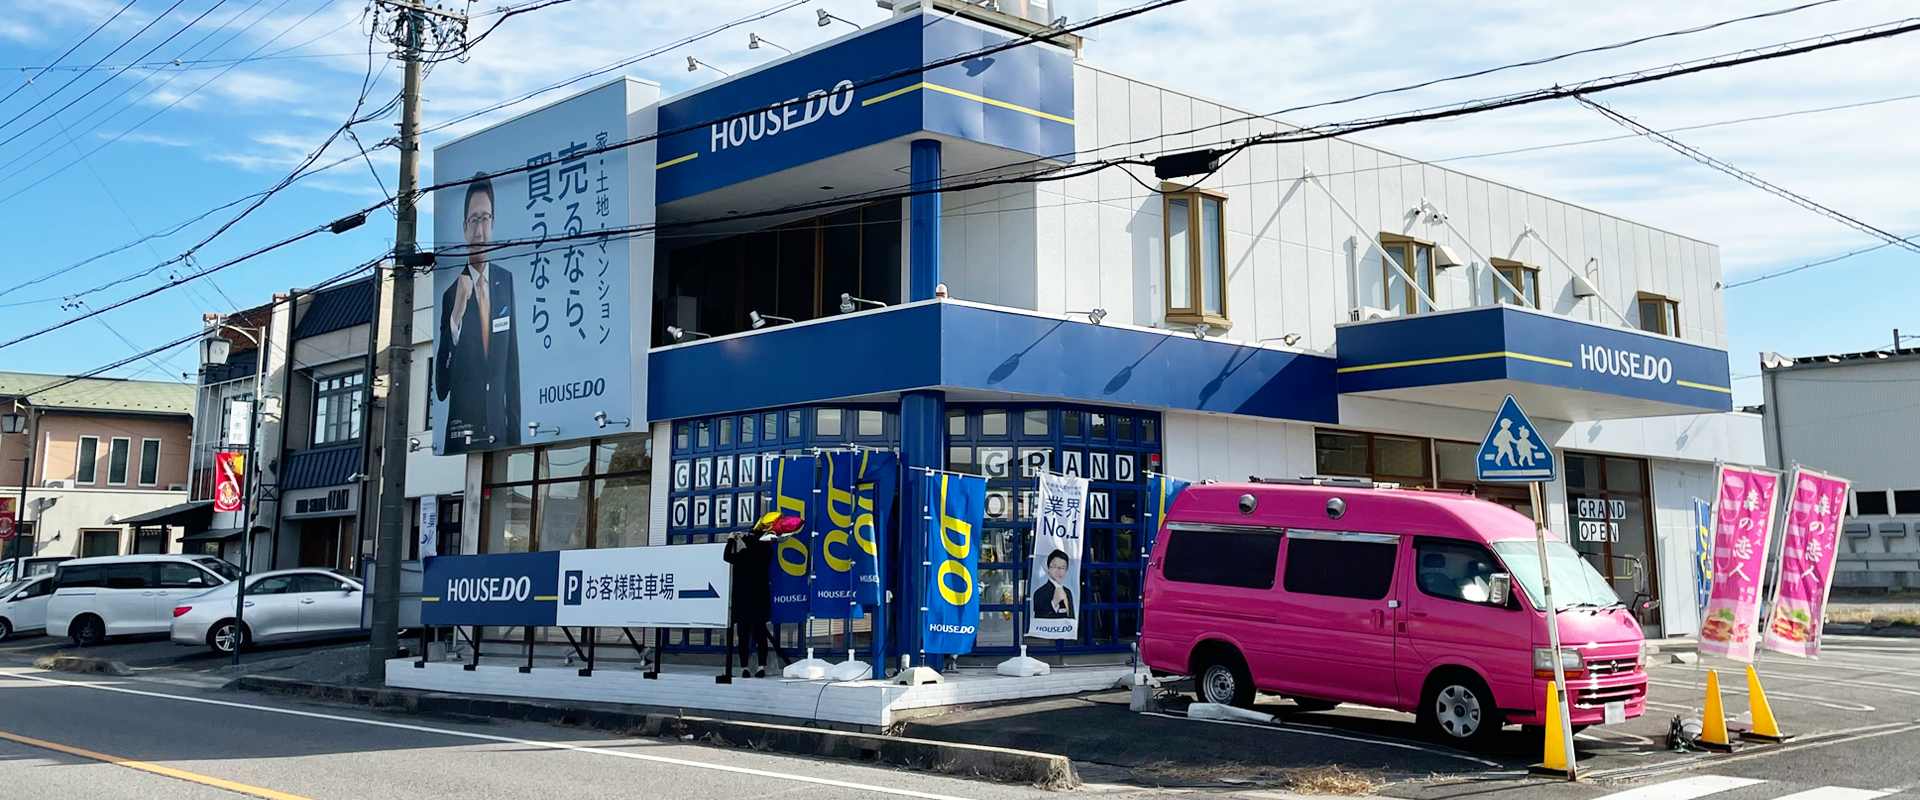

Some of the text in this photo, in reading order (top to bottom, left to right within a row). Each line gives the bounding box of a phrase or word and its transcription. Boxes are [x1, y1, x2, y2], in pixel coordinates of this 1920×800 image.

[526, 151, 554, 350] 買うなら。
[558, 141, 589, 340] 売るなら、
[676, 456, 753, 489] GRAN
[984, 452, 1132, 481] GRAND
[674, 497, 753, 526] OPEN
[1044, 495, 1081, 519] 業界
[1579, 500, 1625, 518] GRAND
[1043, 516, 1079, 540] No.1
[1580, 522, 1618, 541] OPEN
[1728, 488, 1760, 583] 森の恋人
[1801, 494, 1832, 584] 森の恋人
[585, 573, 675, 601] お客様駐車場
